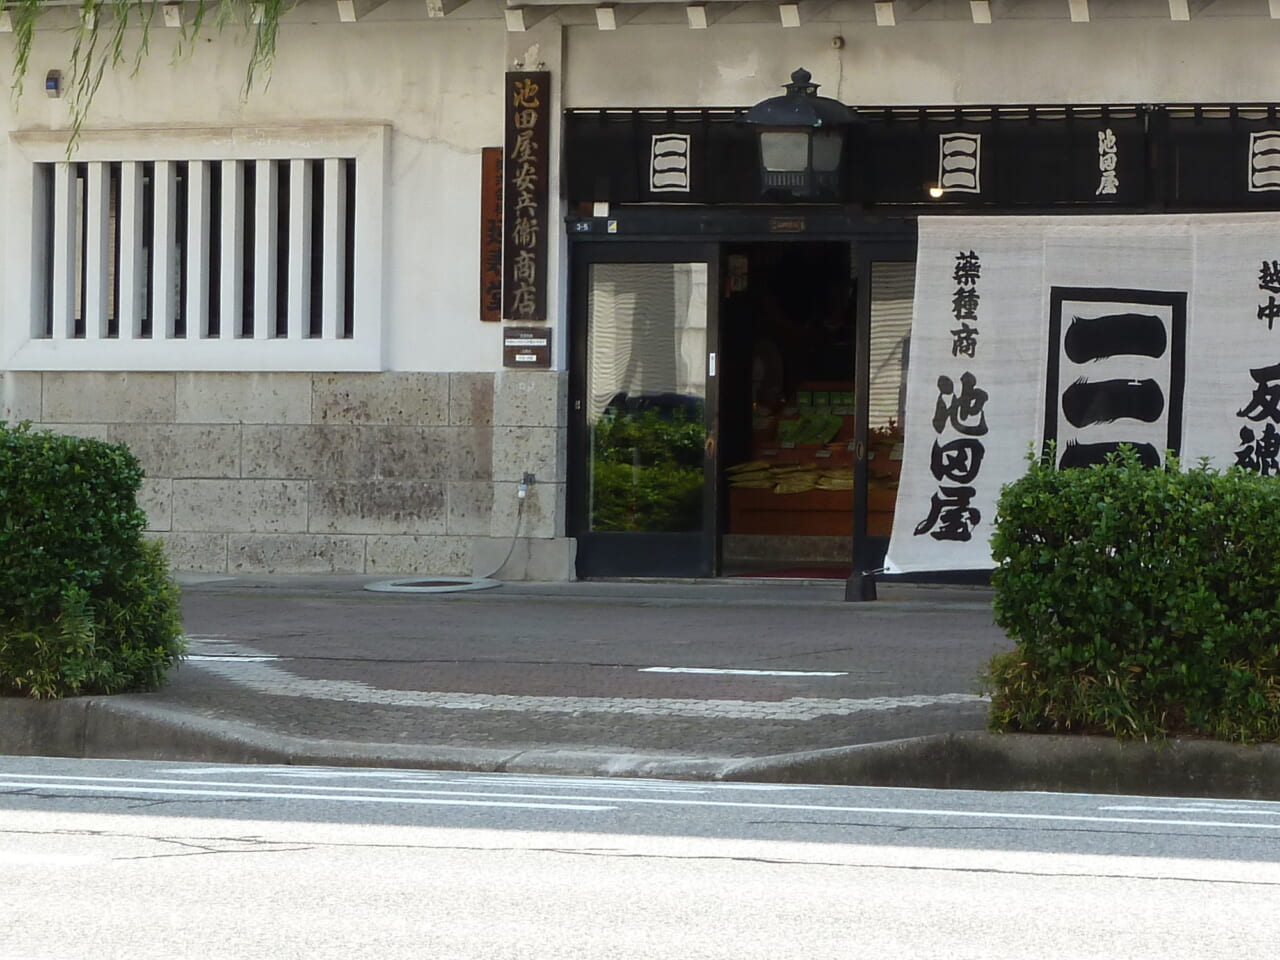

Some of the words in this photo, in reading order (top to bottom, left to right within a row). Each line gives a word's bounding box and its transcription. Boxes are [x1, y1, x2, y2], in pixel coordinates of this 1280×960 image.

[1096, 128, 1119, 196] 池田屋
[912, 371, 989, 542] 池田屋
